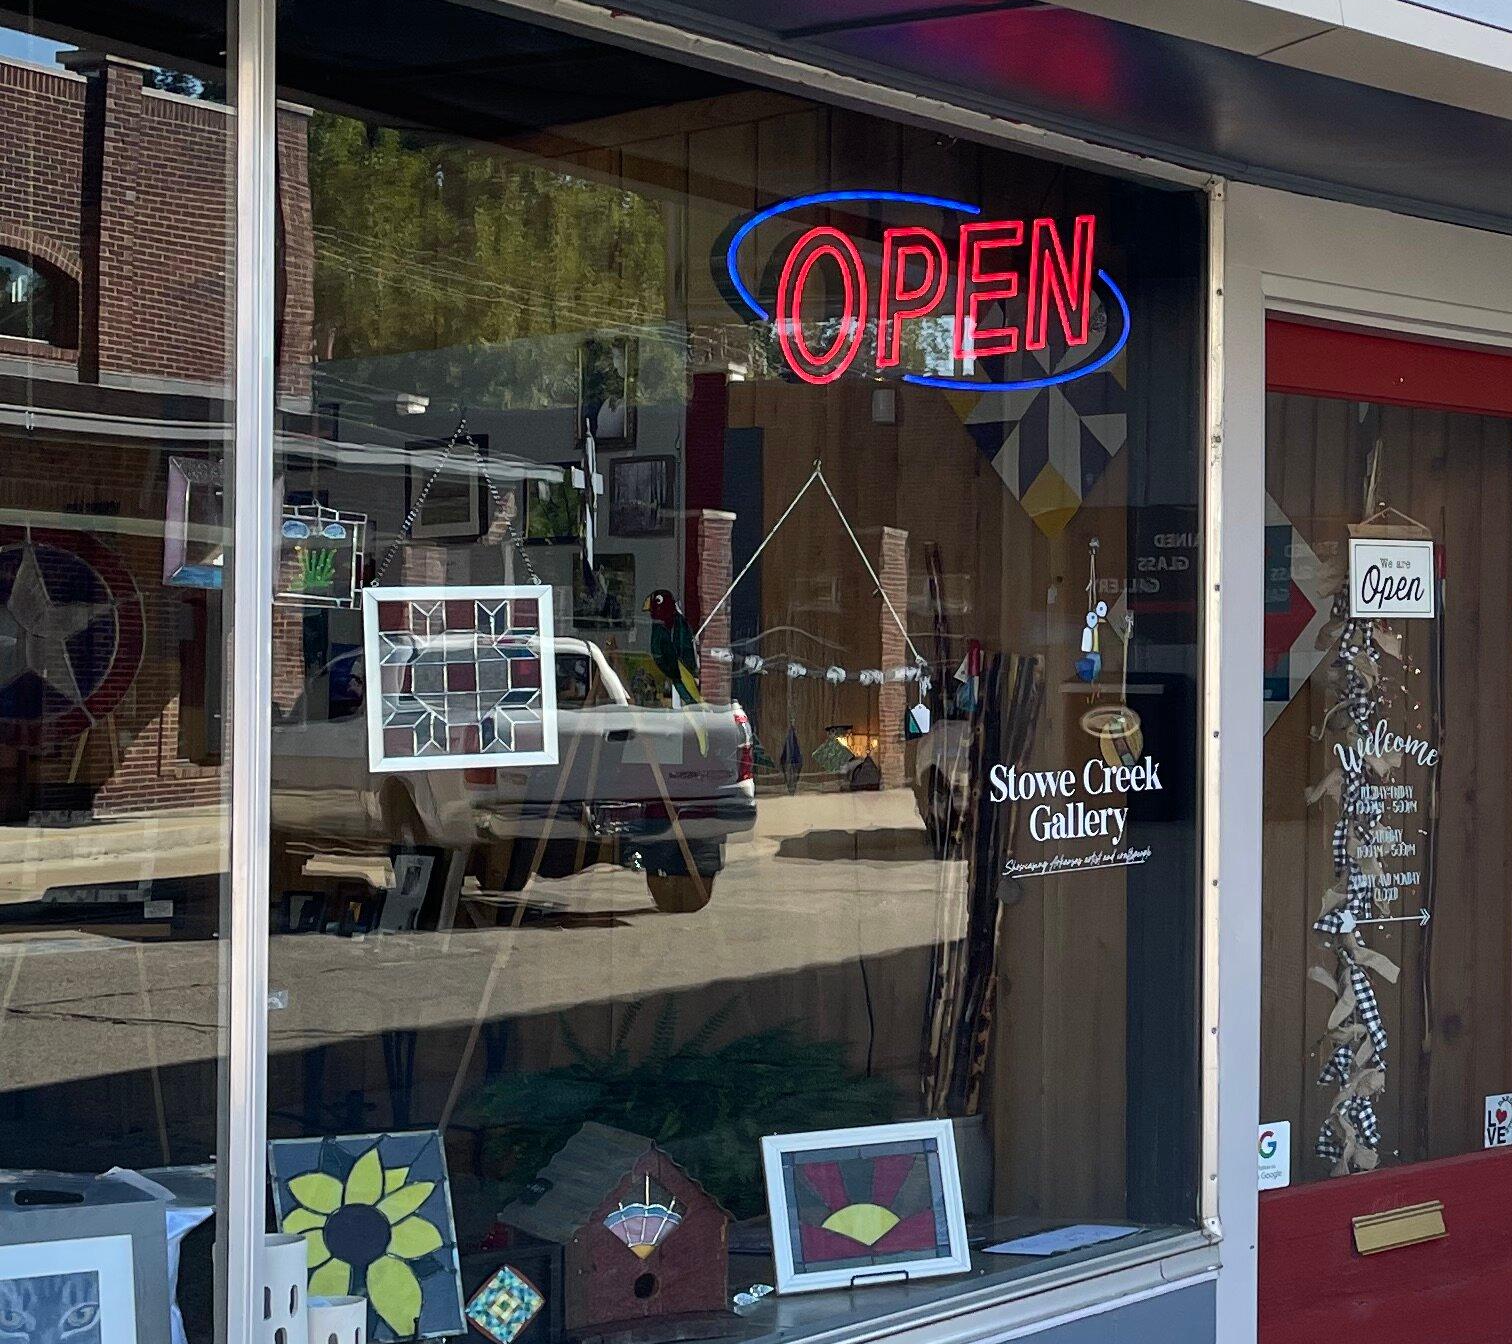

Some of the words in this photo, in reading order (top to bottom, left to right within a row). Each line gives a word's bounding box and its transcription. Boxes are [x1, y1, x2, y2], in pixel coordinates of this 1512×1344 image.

[776, 214, 1096, 385] OPEN
[1361, 564, 1425, 609] Open
[1333, 719, 1438, 773] Welcome
[990, 764, 1076, 804] Stowe
[1083, 756, 1162, 794] Creek
[1029, 801, 1129, 846] Gallery
